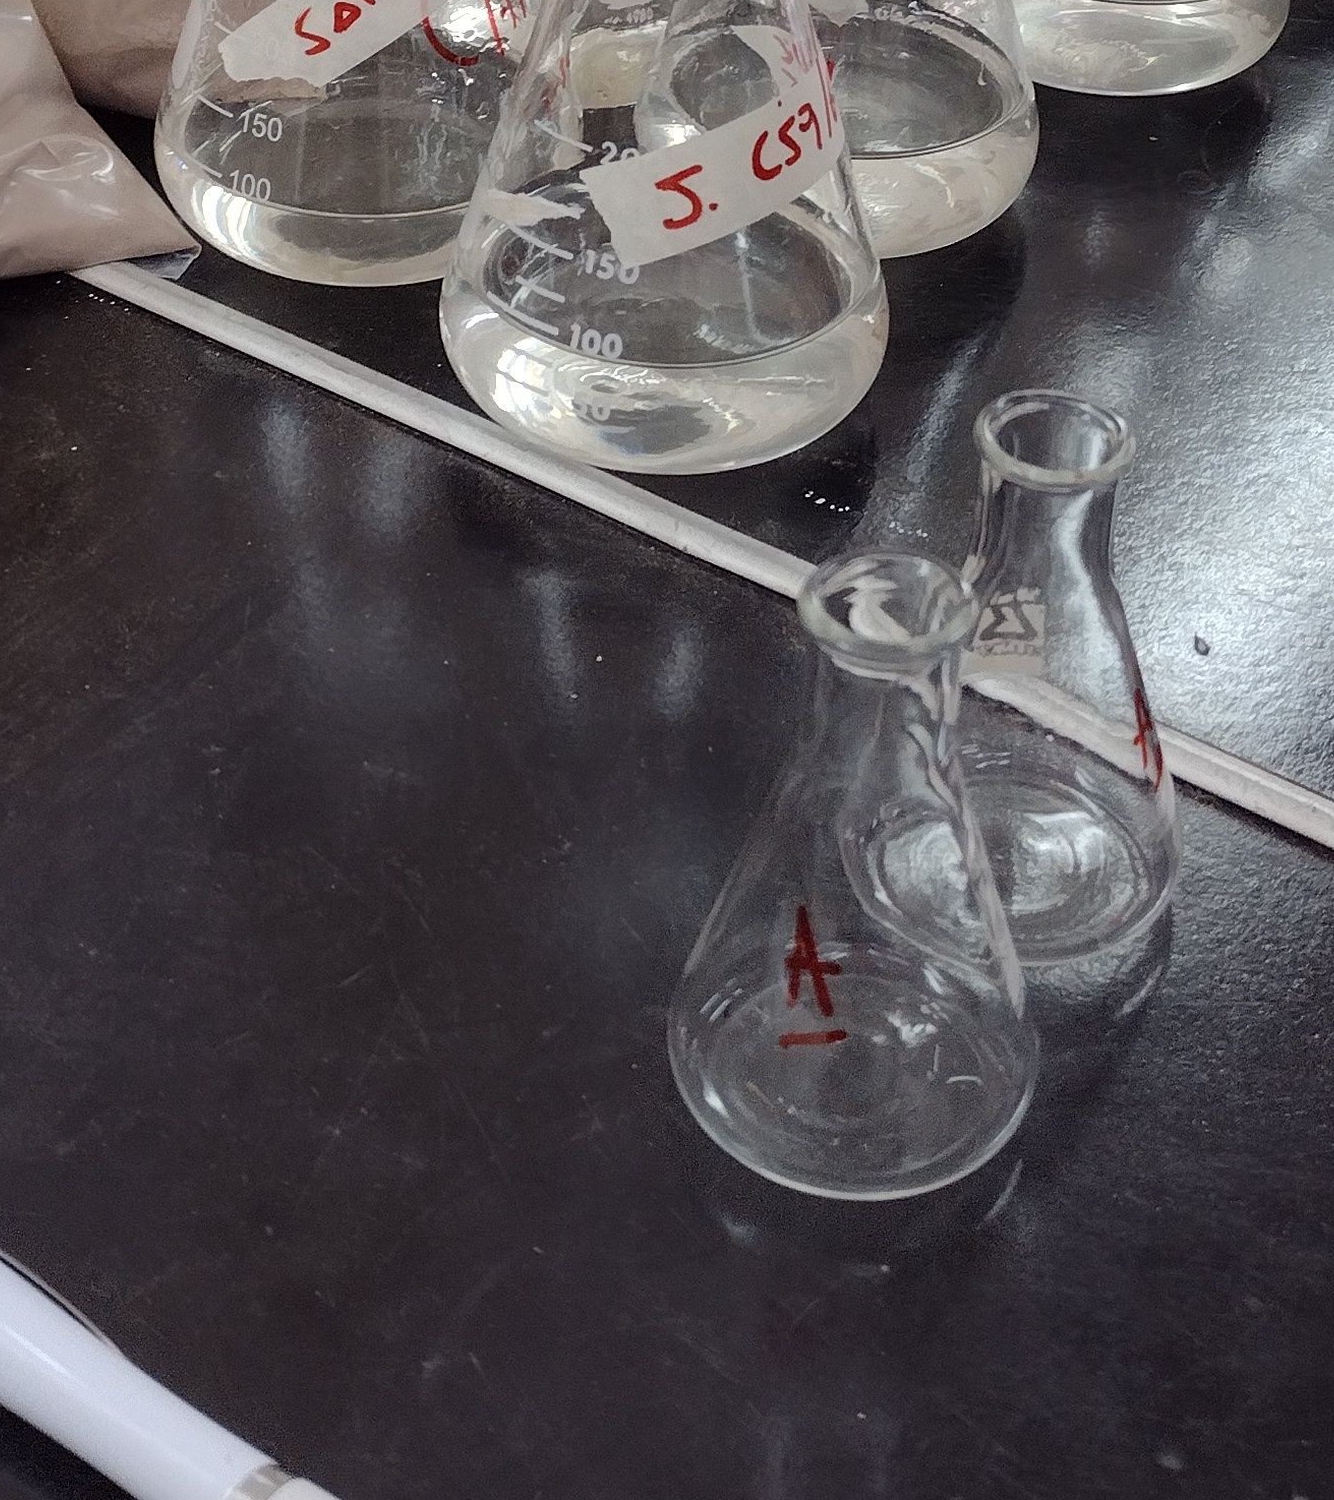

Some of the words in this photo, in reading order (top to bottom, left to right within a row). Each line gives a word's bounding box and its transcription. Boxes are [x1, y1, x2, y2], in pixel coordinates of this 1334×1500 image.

[238, 111, 283, 142] 150
[228, 169, 272, 202] 100
[570, 323, 624, 359] 100
[783, 904, 844, 1019] A
